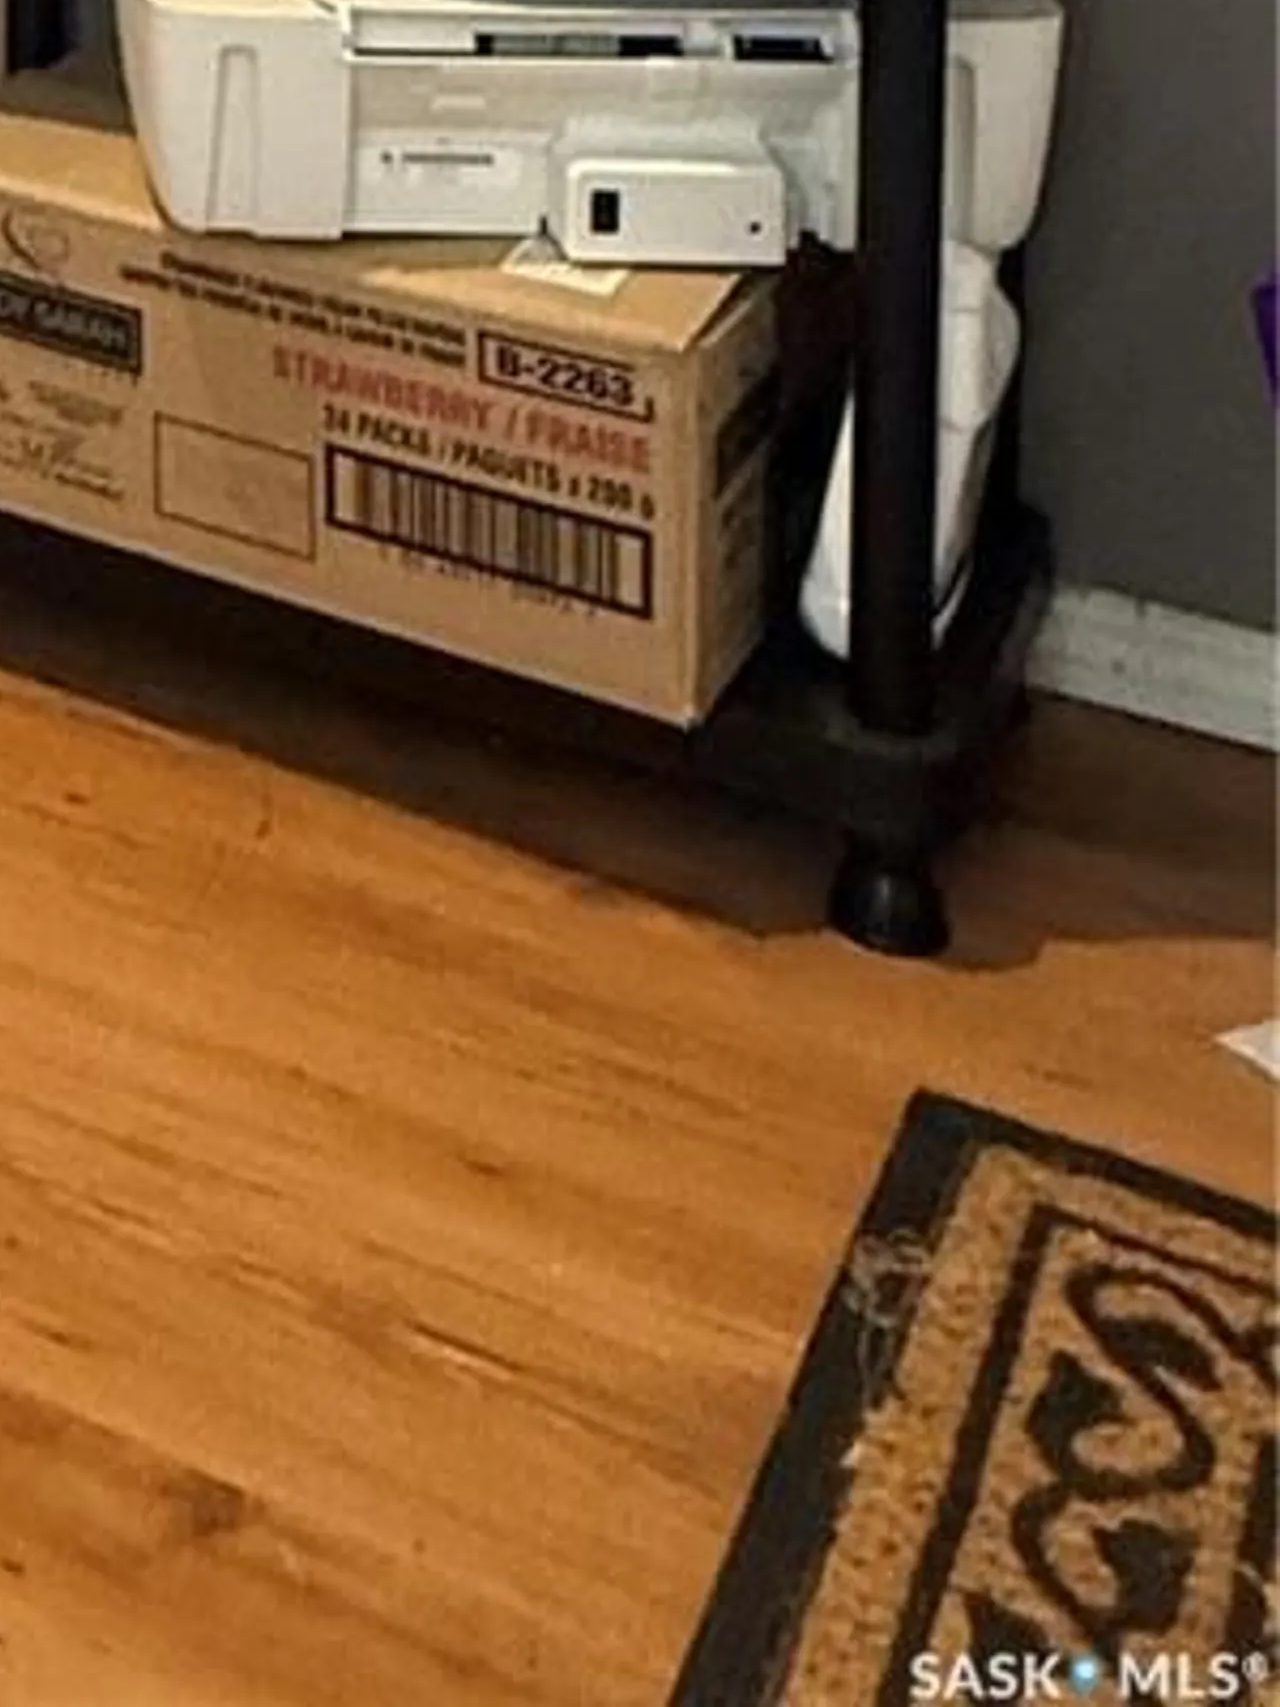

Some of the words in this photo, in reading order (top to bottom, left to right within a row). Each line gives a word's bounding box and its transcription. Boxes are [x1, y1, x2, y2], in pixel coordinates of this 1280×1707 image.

[272, 345, 495, 432] STRAWBERRY
[524, 404, 651, 473] FRAISE
[496, 344, 635, 406] B-2263
[356, 409, 431, 456] PACKS
[451, 437, 561, 494] PAQUETS
